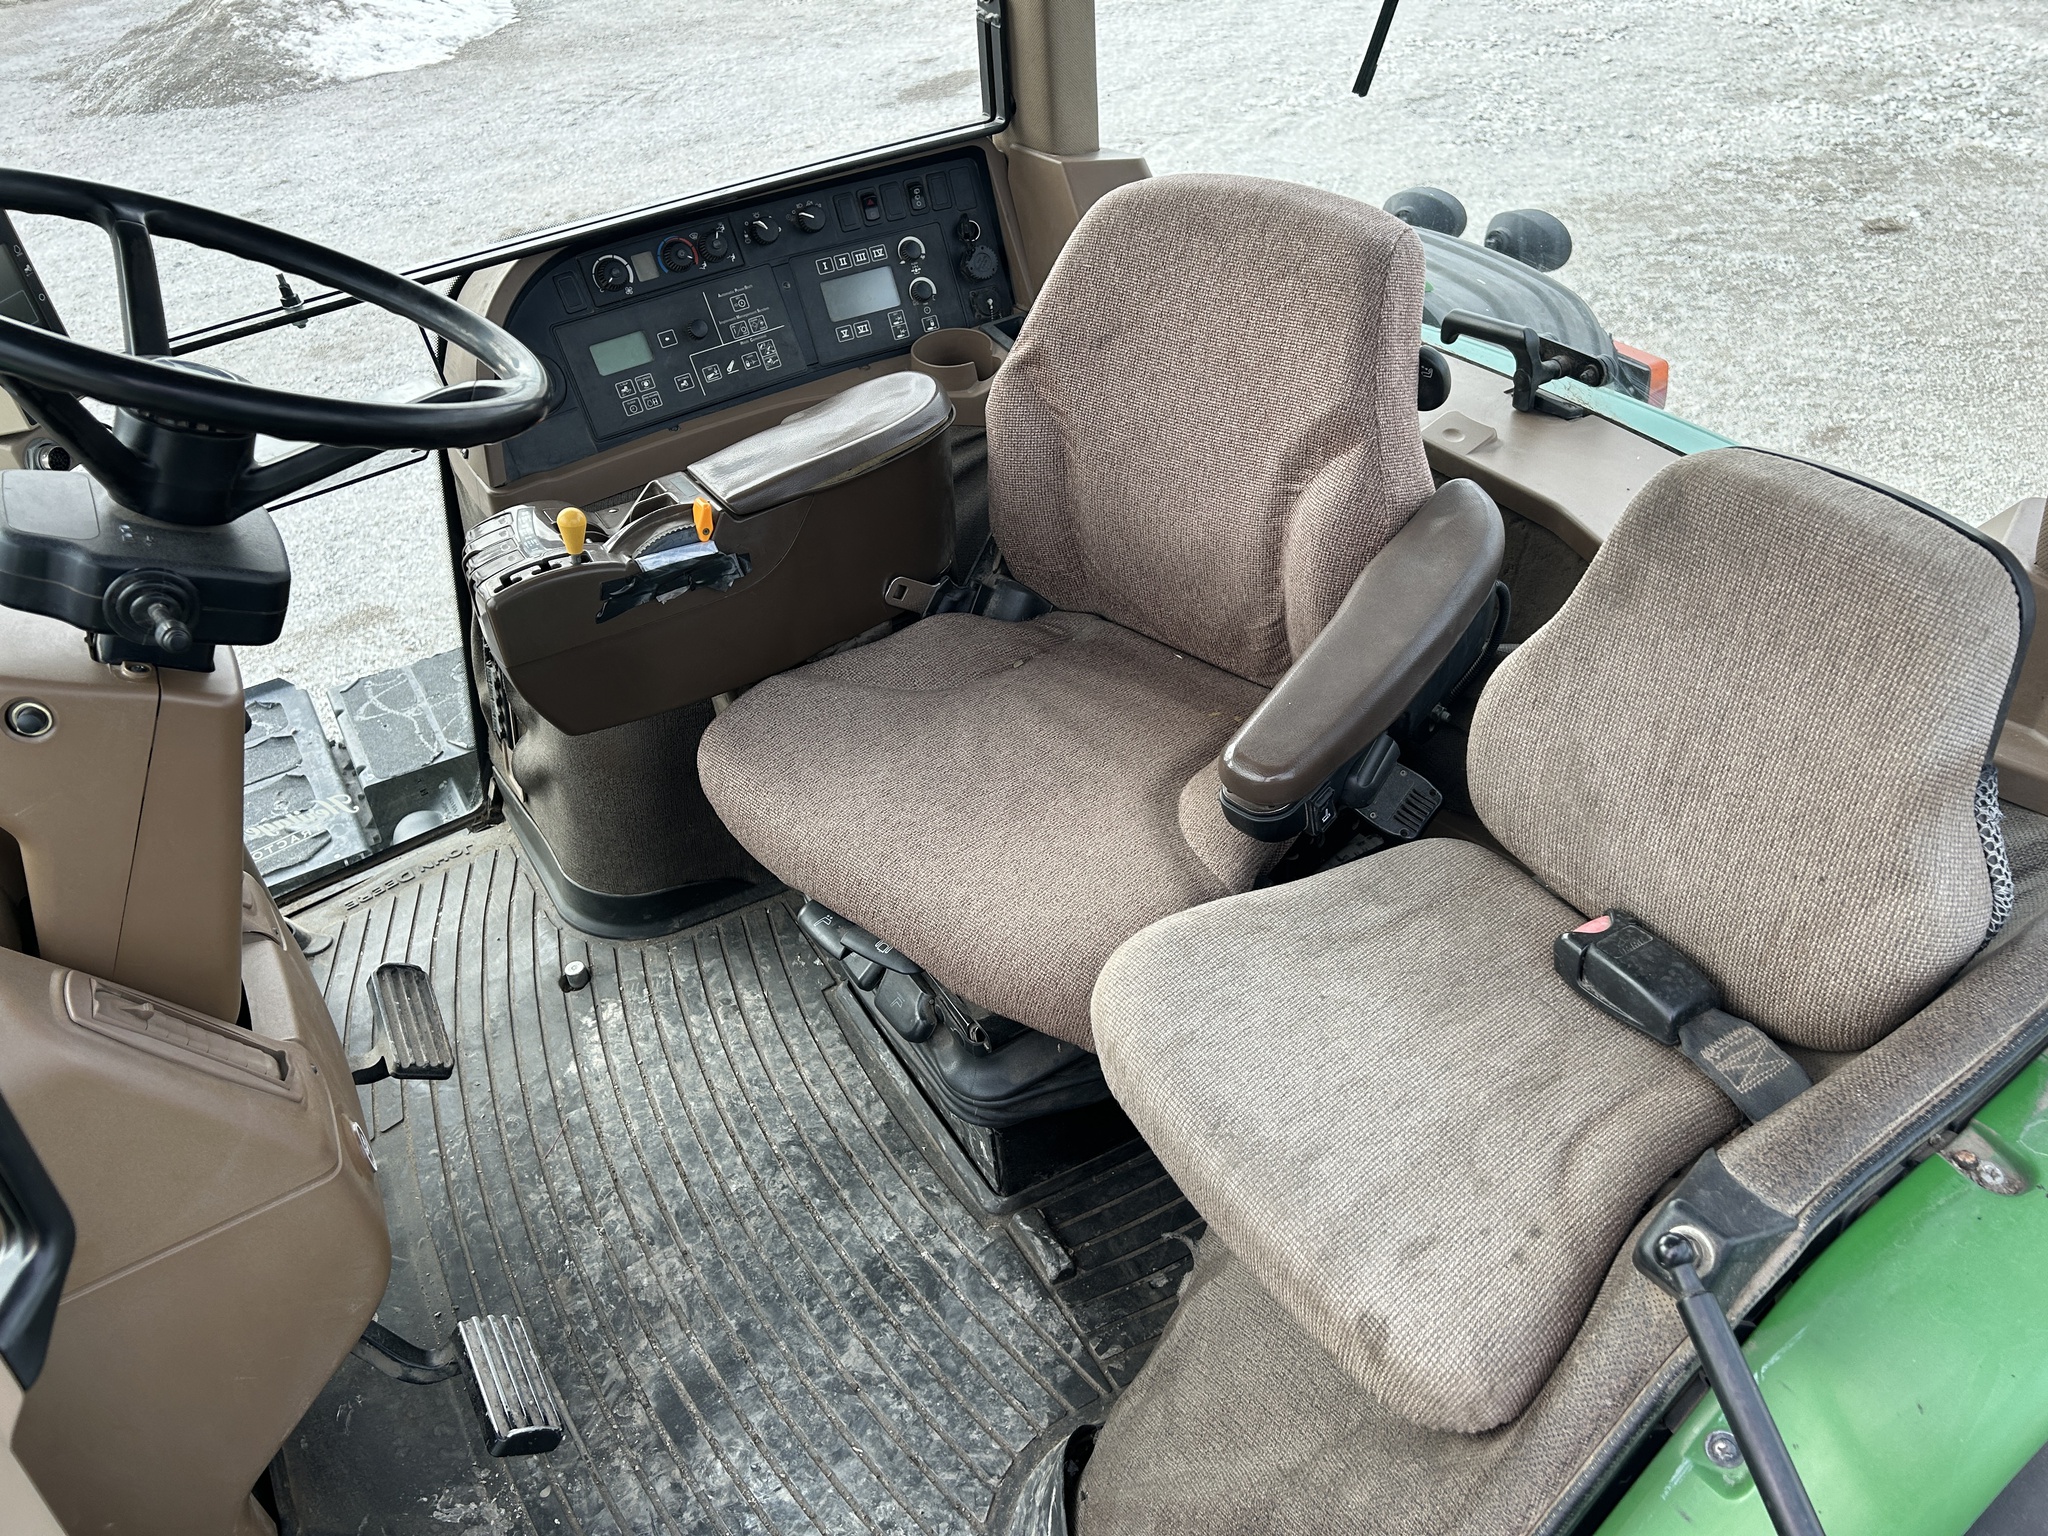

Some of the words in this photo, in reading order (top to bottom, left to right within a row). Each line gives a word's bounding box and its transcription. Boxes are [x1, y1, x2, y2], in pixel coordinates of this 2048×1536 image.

[854, 252, 867, 262] III
[872, 248, 885, 258] IV
[838, 257, 848, 266] II
[840, 329, 850, 338] V
[857, 324, 869, 334] VI
[420, 844, 474, 873] JOHN
[344, 867, 416, 911] DEERE
